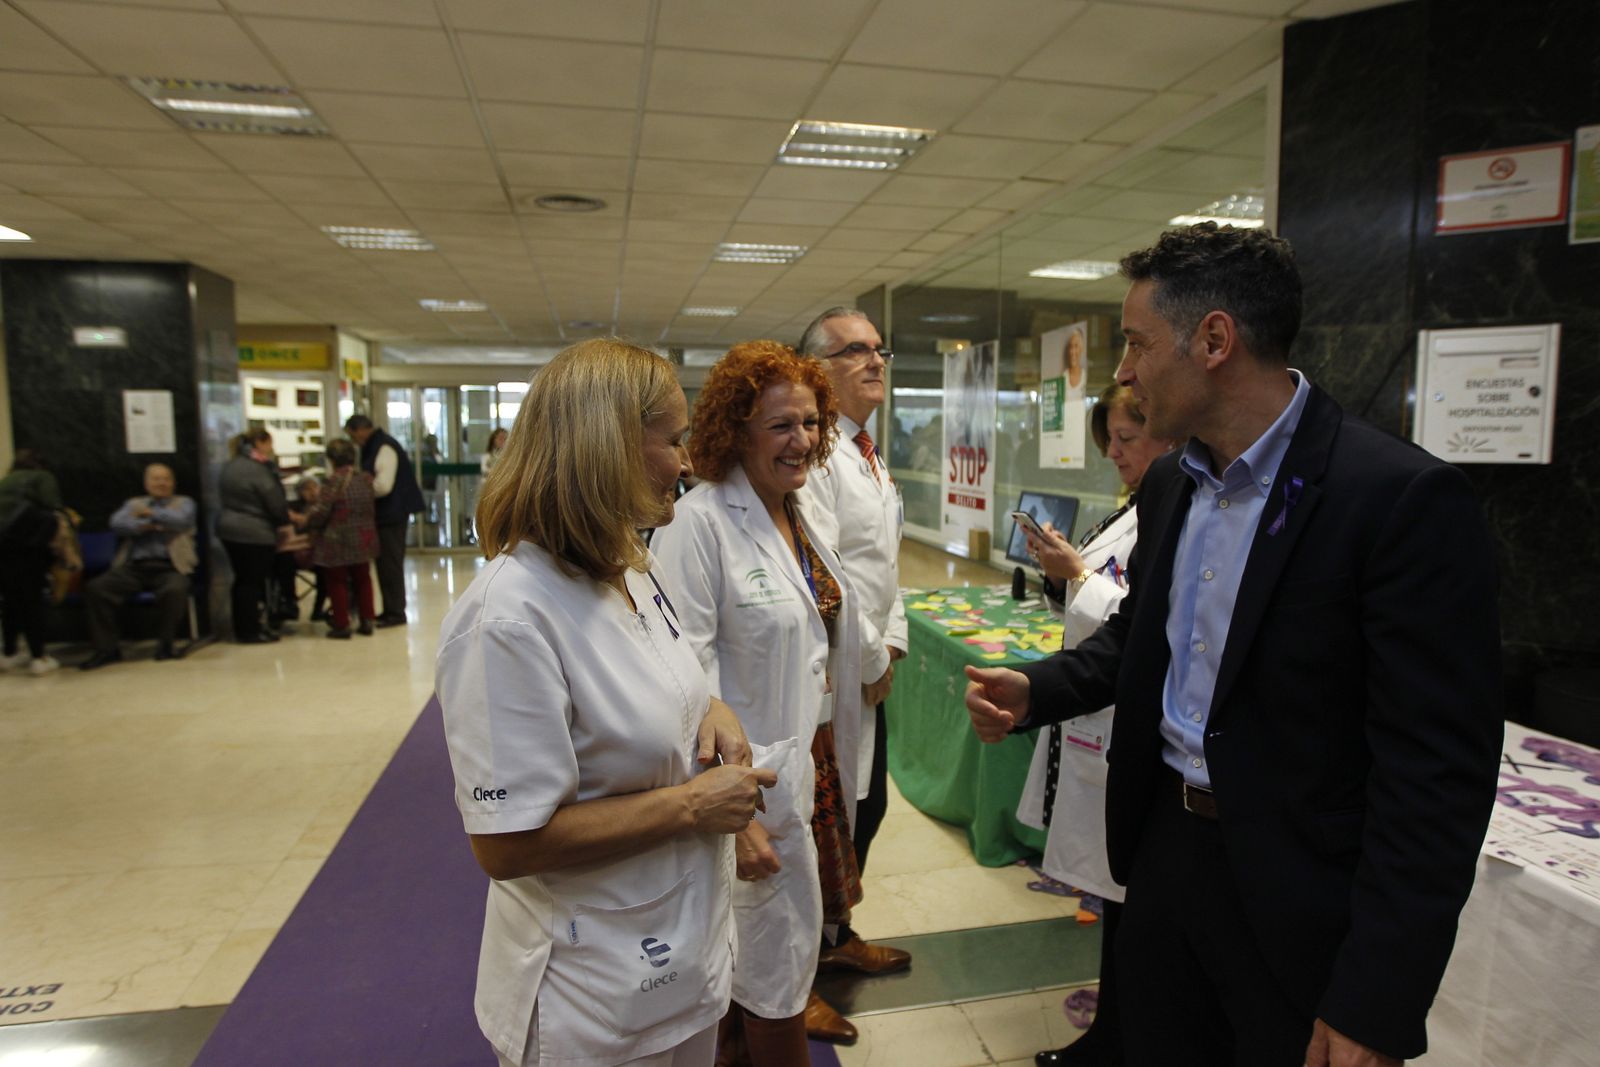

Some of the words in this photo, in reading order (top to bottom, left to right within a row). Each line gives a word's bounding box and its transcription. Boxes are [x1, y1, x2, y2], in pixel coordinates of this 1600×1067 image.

[1465, 378, 1525, 390] ENCUESTAS
[1477, 392, 1511, 404] SOBRE
[1448, 406, 1540, 418] HOSPITALIZACIÓN
[950, 447, 988, 487] STOP
[473, 786, 508, 802] Clece
[640, 971, 679, 993] Clece
